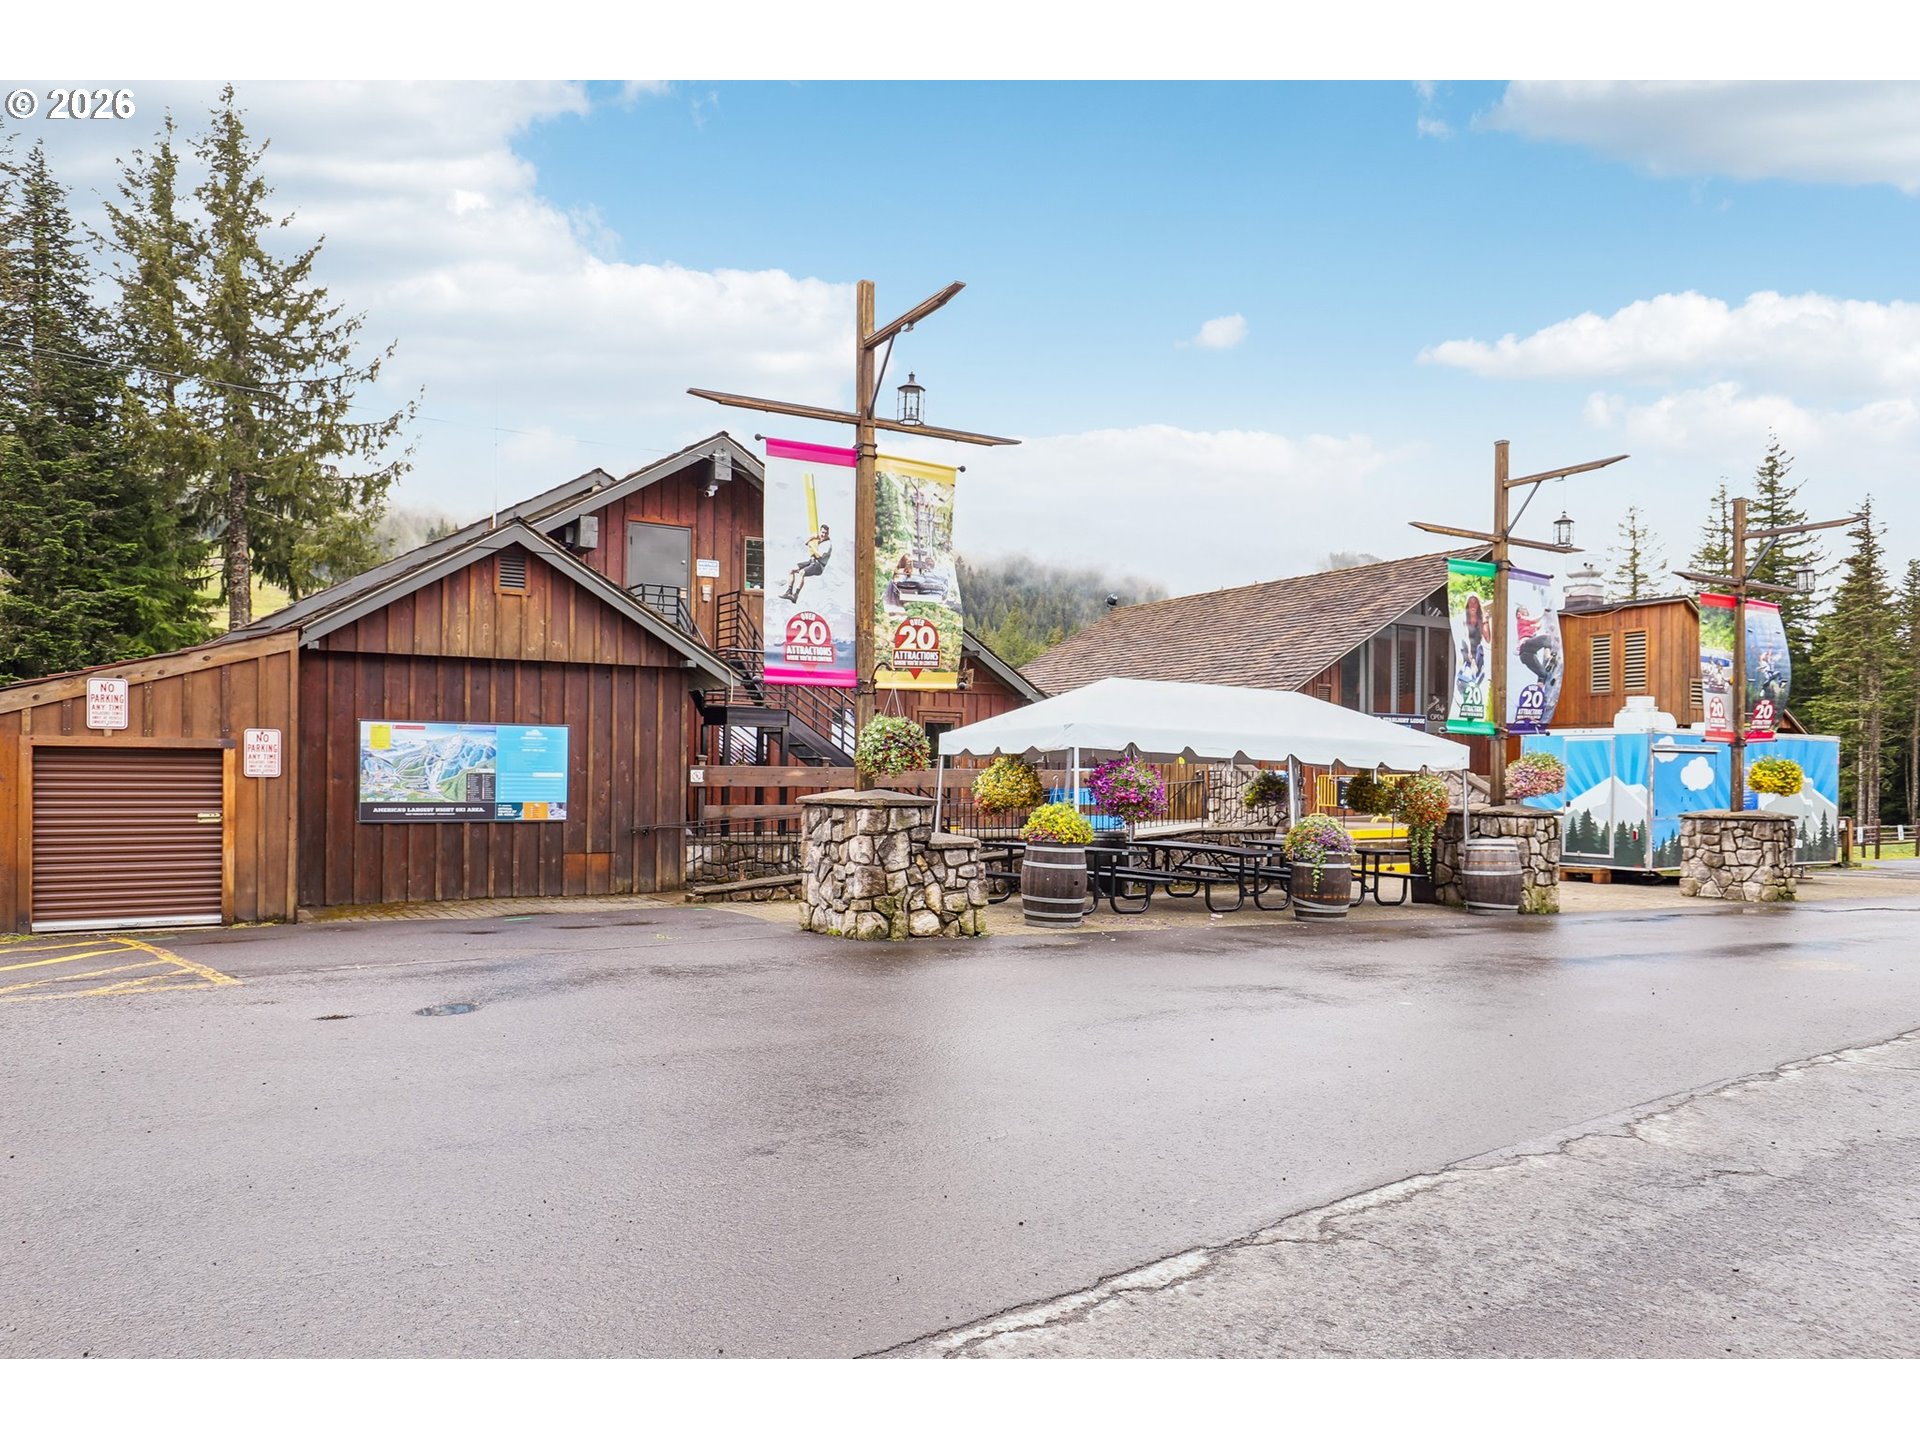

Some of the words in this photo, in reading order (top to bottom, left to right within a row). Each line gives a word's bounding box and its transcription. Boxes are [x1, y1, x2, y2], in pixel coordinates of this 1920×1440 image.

[800, 612, 816, 621] OVER
[909, 618, 925, 627] OVER
[790, 620, 827, 645] 20
[898, 625, 936, 650] 20
[787, 645, 833, 657] ATTRACTIONS
[894, 651, 939, 660] ATTRACTIONS
[100, 683, 115, 693] NO
[91, 694, 124, 703] PARKING
[1465, 686, 1481, 705] 20
[1521, 690, 1544, 708] 20
[1710, 702, 1724, 717] 20
[1755, 704, 1773, 719] 20
[256, 734, 269, 742] NO
[248, 744, 277, 753] PARKING
